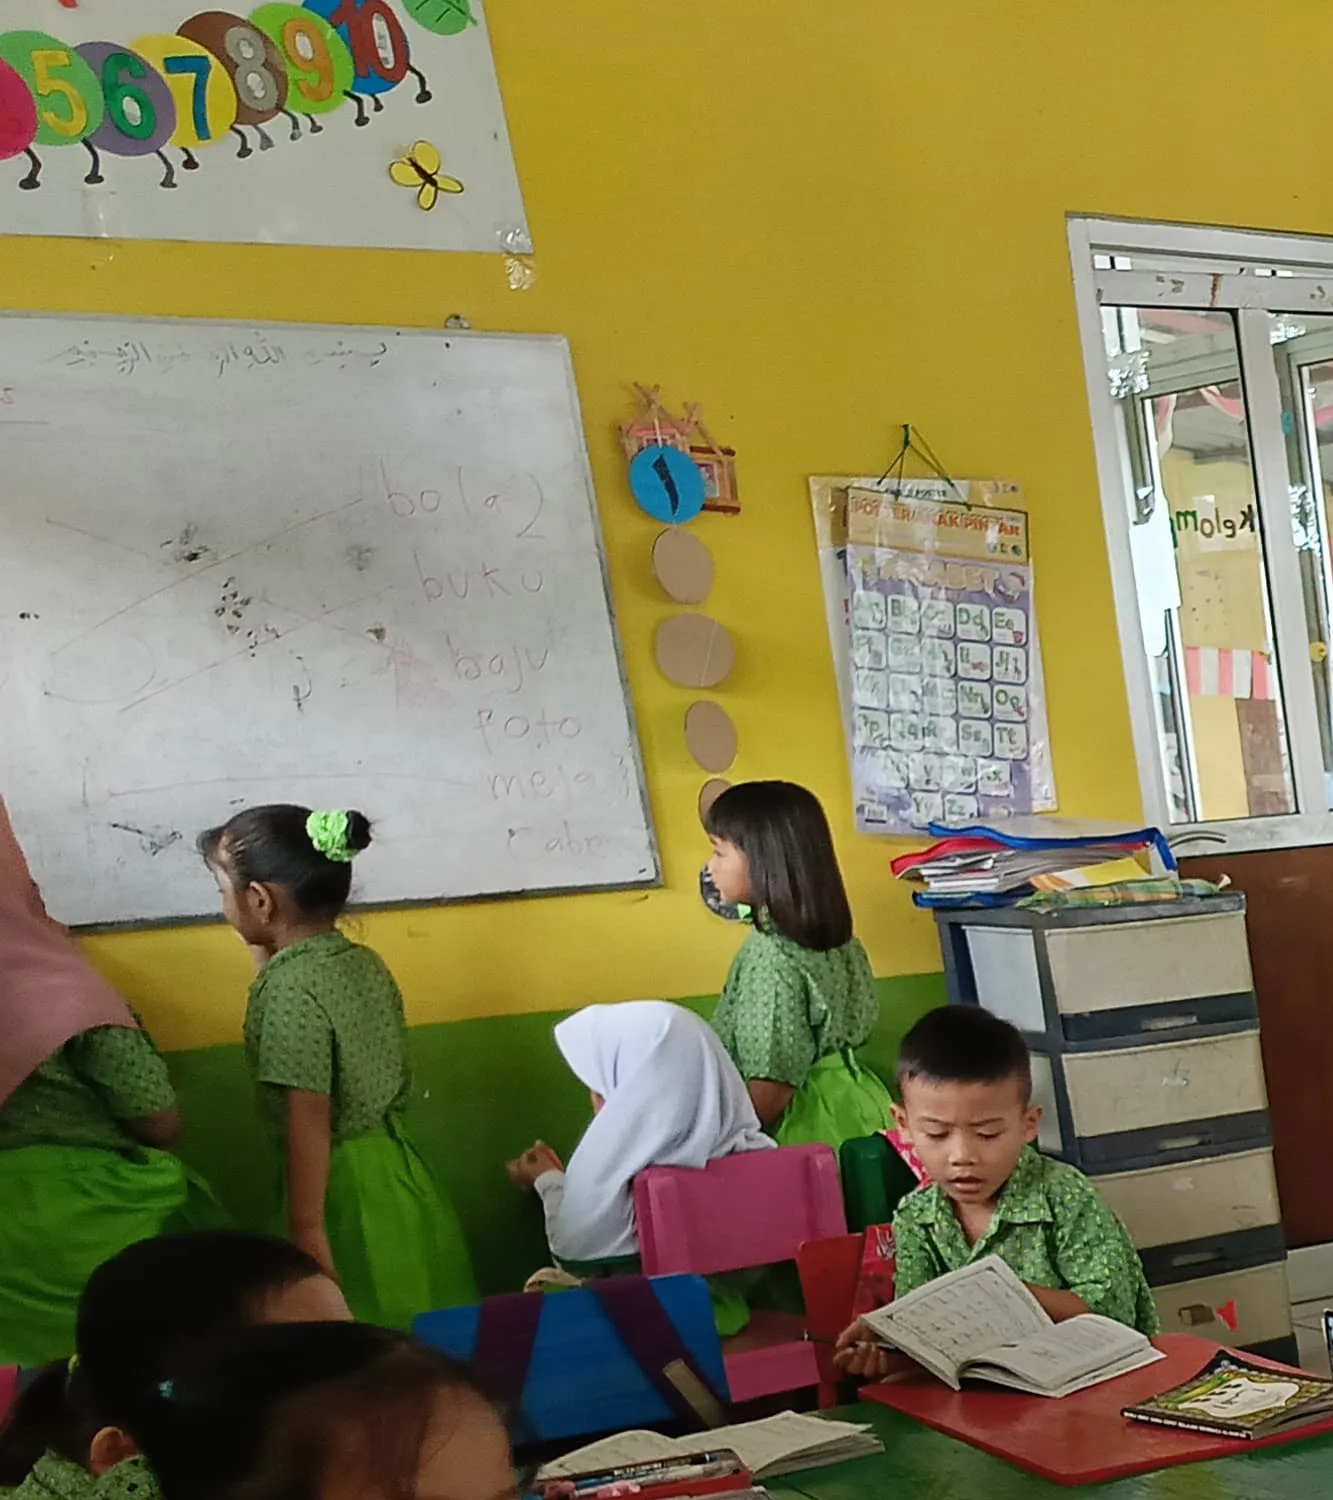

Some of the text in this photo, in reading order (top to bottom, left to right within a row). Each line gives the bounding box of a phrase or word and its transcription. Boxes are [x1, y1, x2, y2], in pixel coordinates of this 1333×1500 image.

[30, 0, 409, 141] 5 6 7 8 9 10
